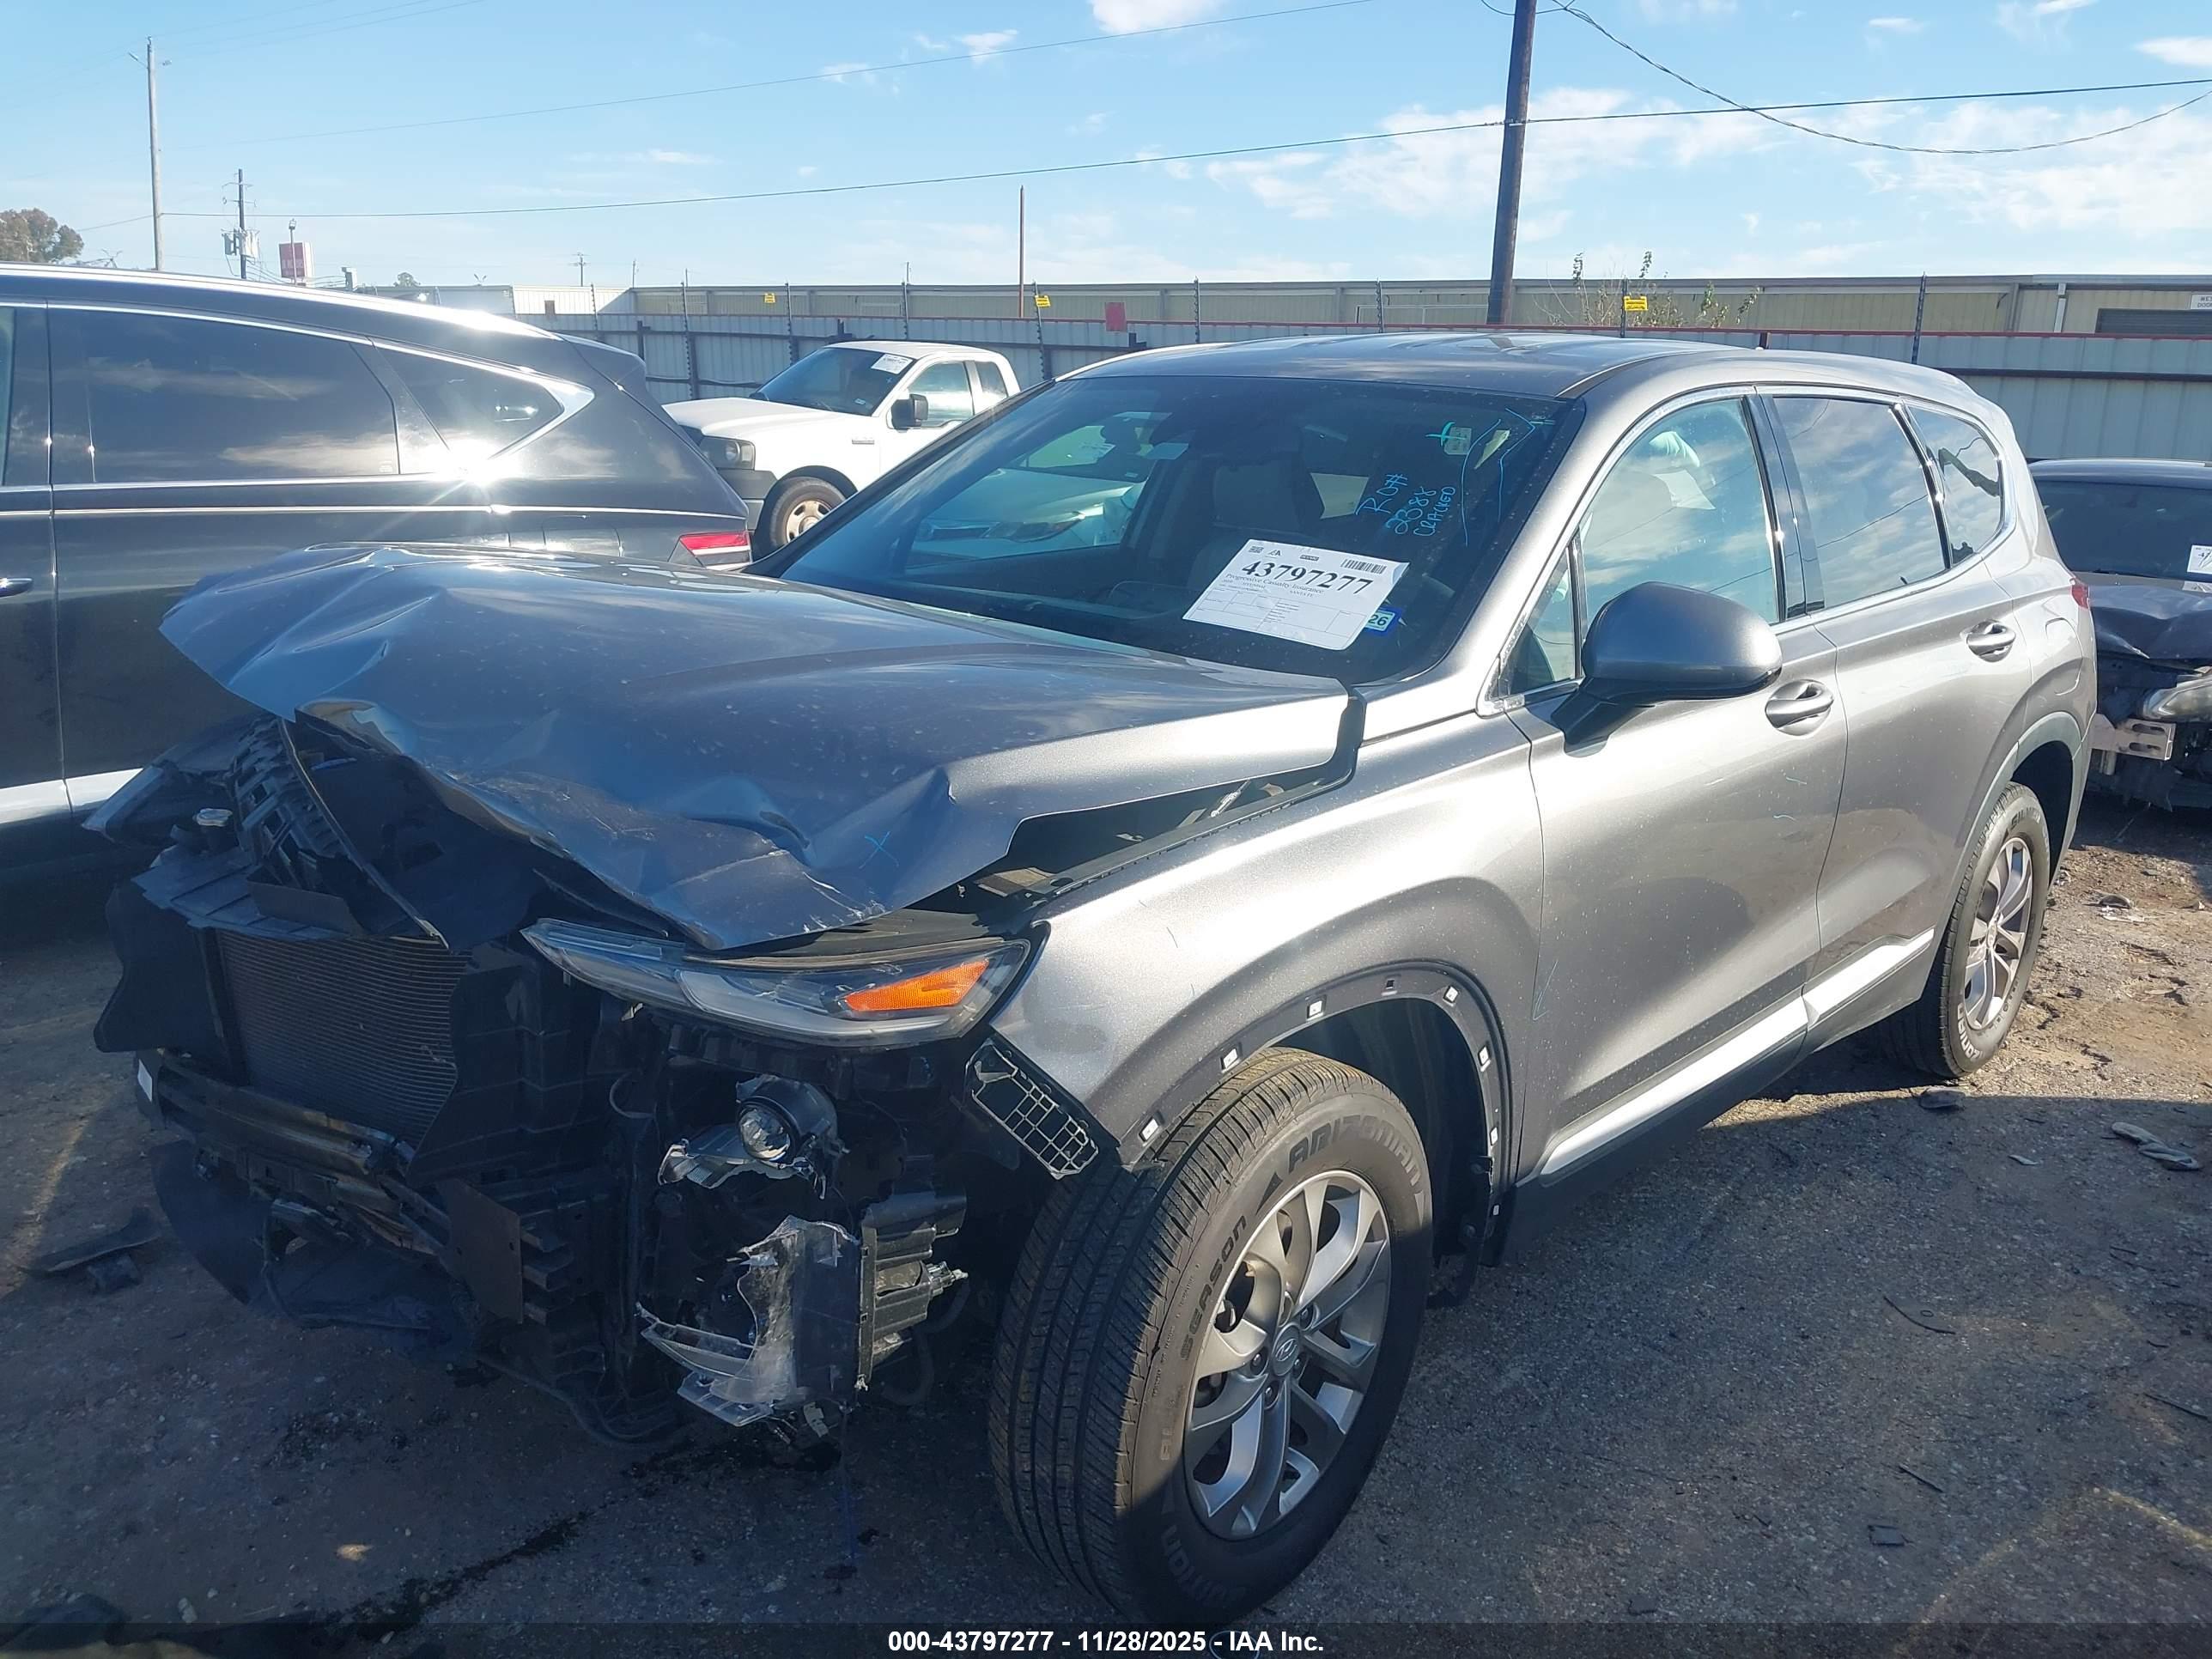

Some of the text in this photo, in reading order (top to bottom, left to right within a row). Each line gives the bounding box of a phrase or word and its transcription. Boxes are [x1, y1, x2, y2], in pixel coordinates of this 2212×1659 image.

[1413, 487, 1455, 536] CRACKED
[1242, 561, 1374, 594] 43797277
[1368, 615, 1389, 626] 26
[1180, 1216, 1247, 1361] SEASON
